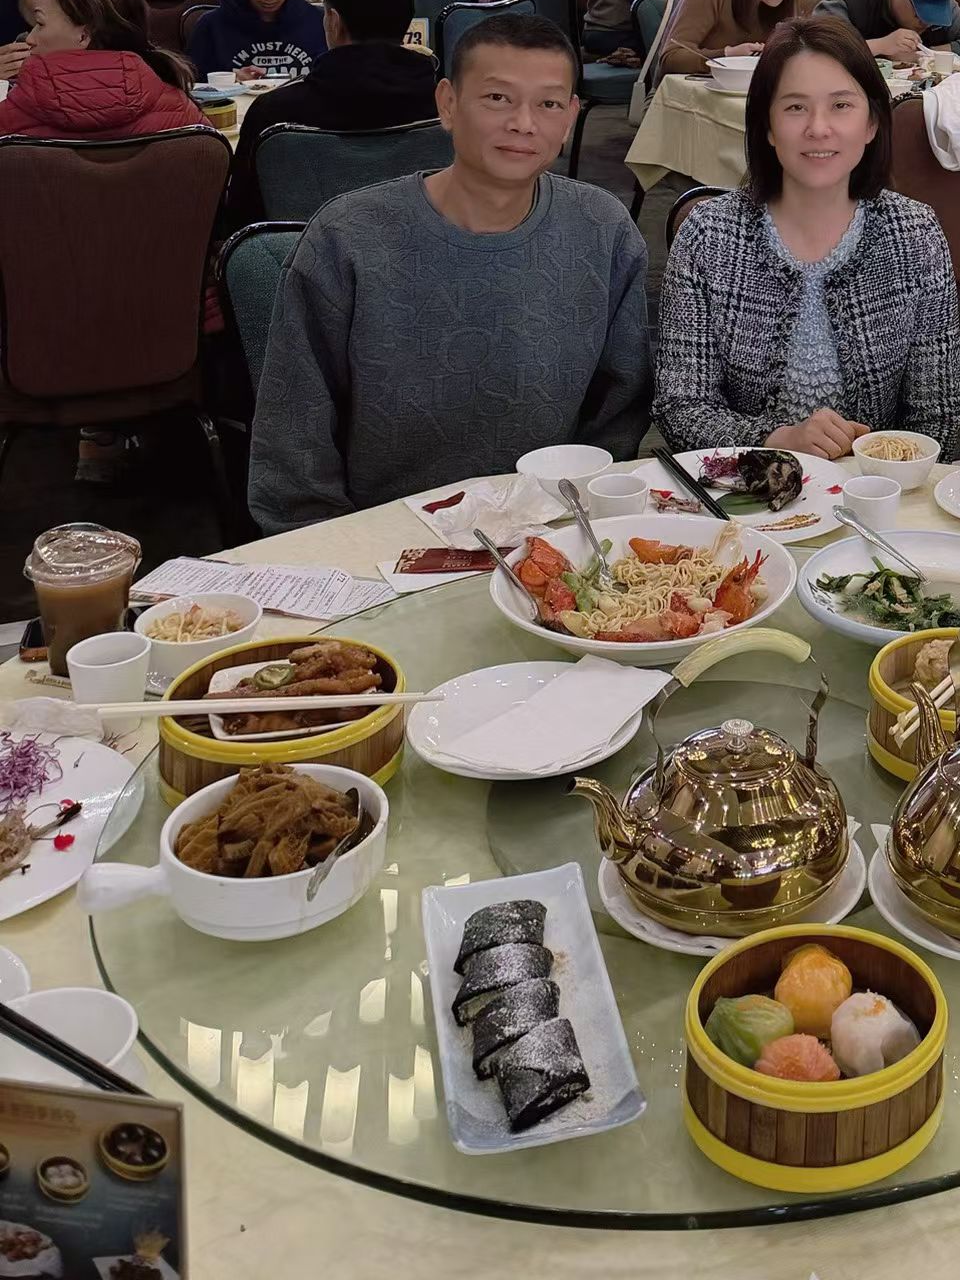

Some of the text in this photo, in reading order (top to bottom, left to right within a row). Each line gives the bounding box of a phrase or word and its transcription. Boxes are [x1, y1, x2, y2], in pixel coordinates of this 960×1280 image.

[401, 31, 422, 45] 73
[232, 41, 312, 66] I'M JUST HERE
[257, 55, 289, 64] FOR THE
